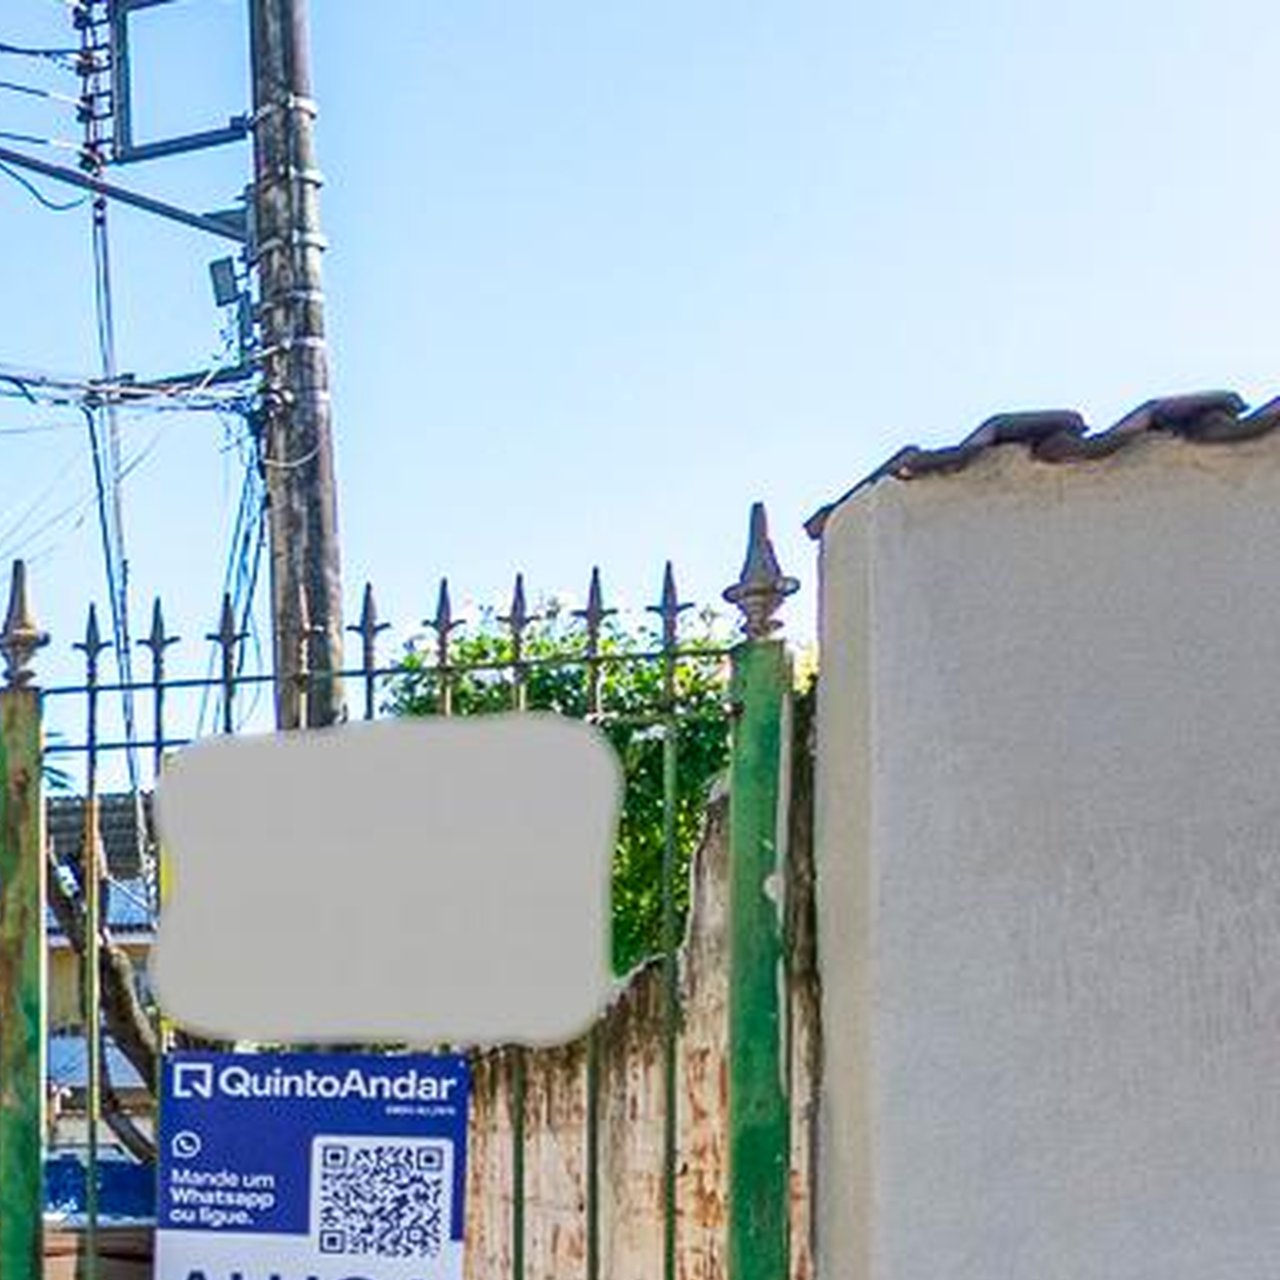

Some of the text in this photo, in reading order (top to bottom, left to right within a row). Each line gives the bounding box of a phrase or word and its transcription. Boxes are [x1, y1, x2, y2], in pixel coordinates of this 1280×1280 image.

[219, 1066, 456, 1100] QuintoAndar
[170, 1168, 275, 1188] Mande um
[169, 1206, 254, 1227] ou ligue.
